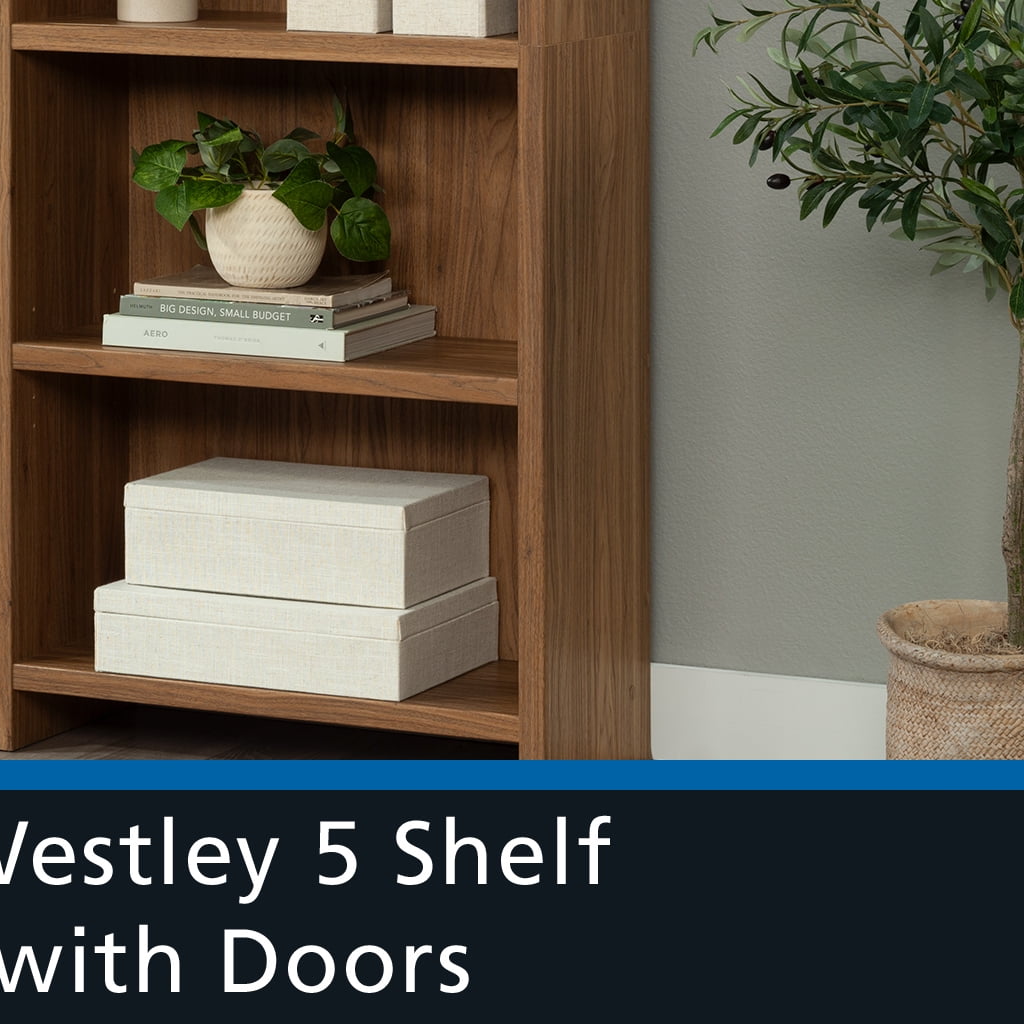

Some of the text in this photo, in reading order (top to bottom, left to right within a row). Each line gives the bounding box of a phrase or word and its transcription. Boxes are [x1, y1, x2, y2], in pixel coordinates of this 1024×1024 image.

[160, 304, 291, 321] BIG DESIGN, SMALL BUDGET
[144, 330, 168, 338] AERO
